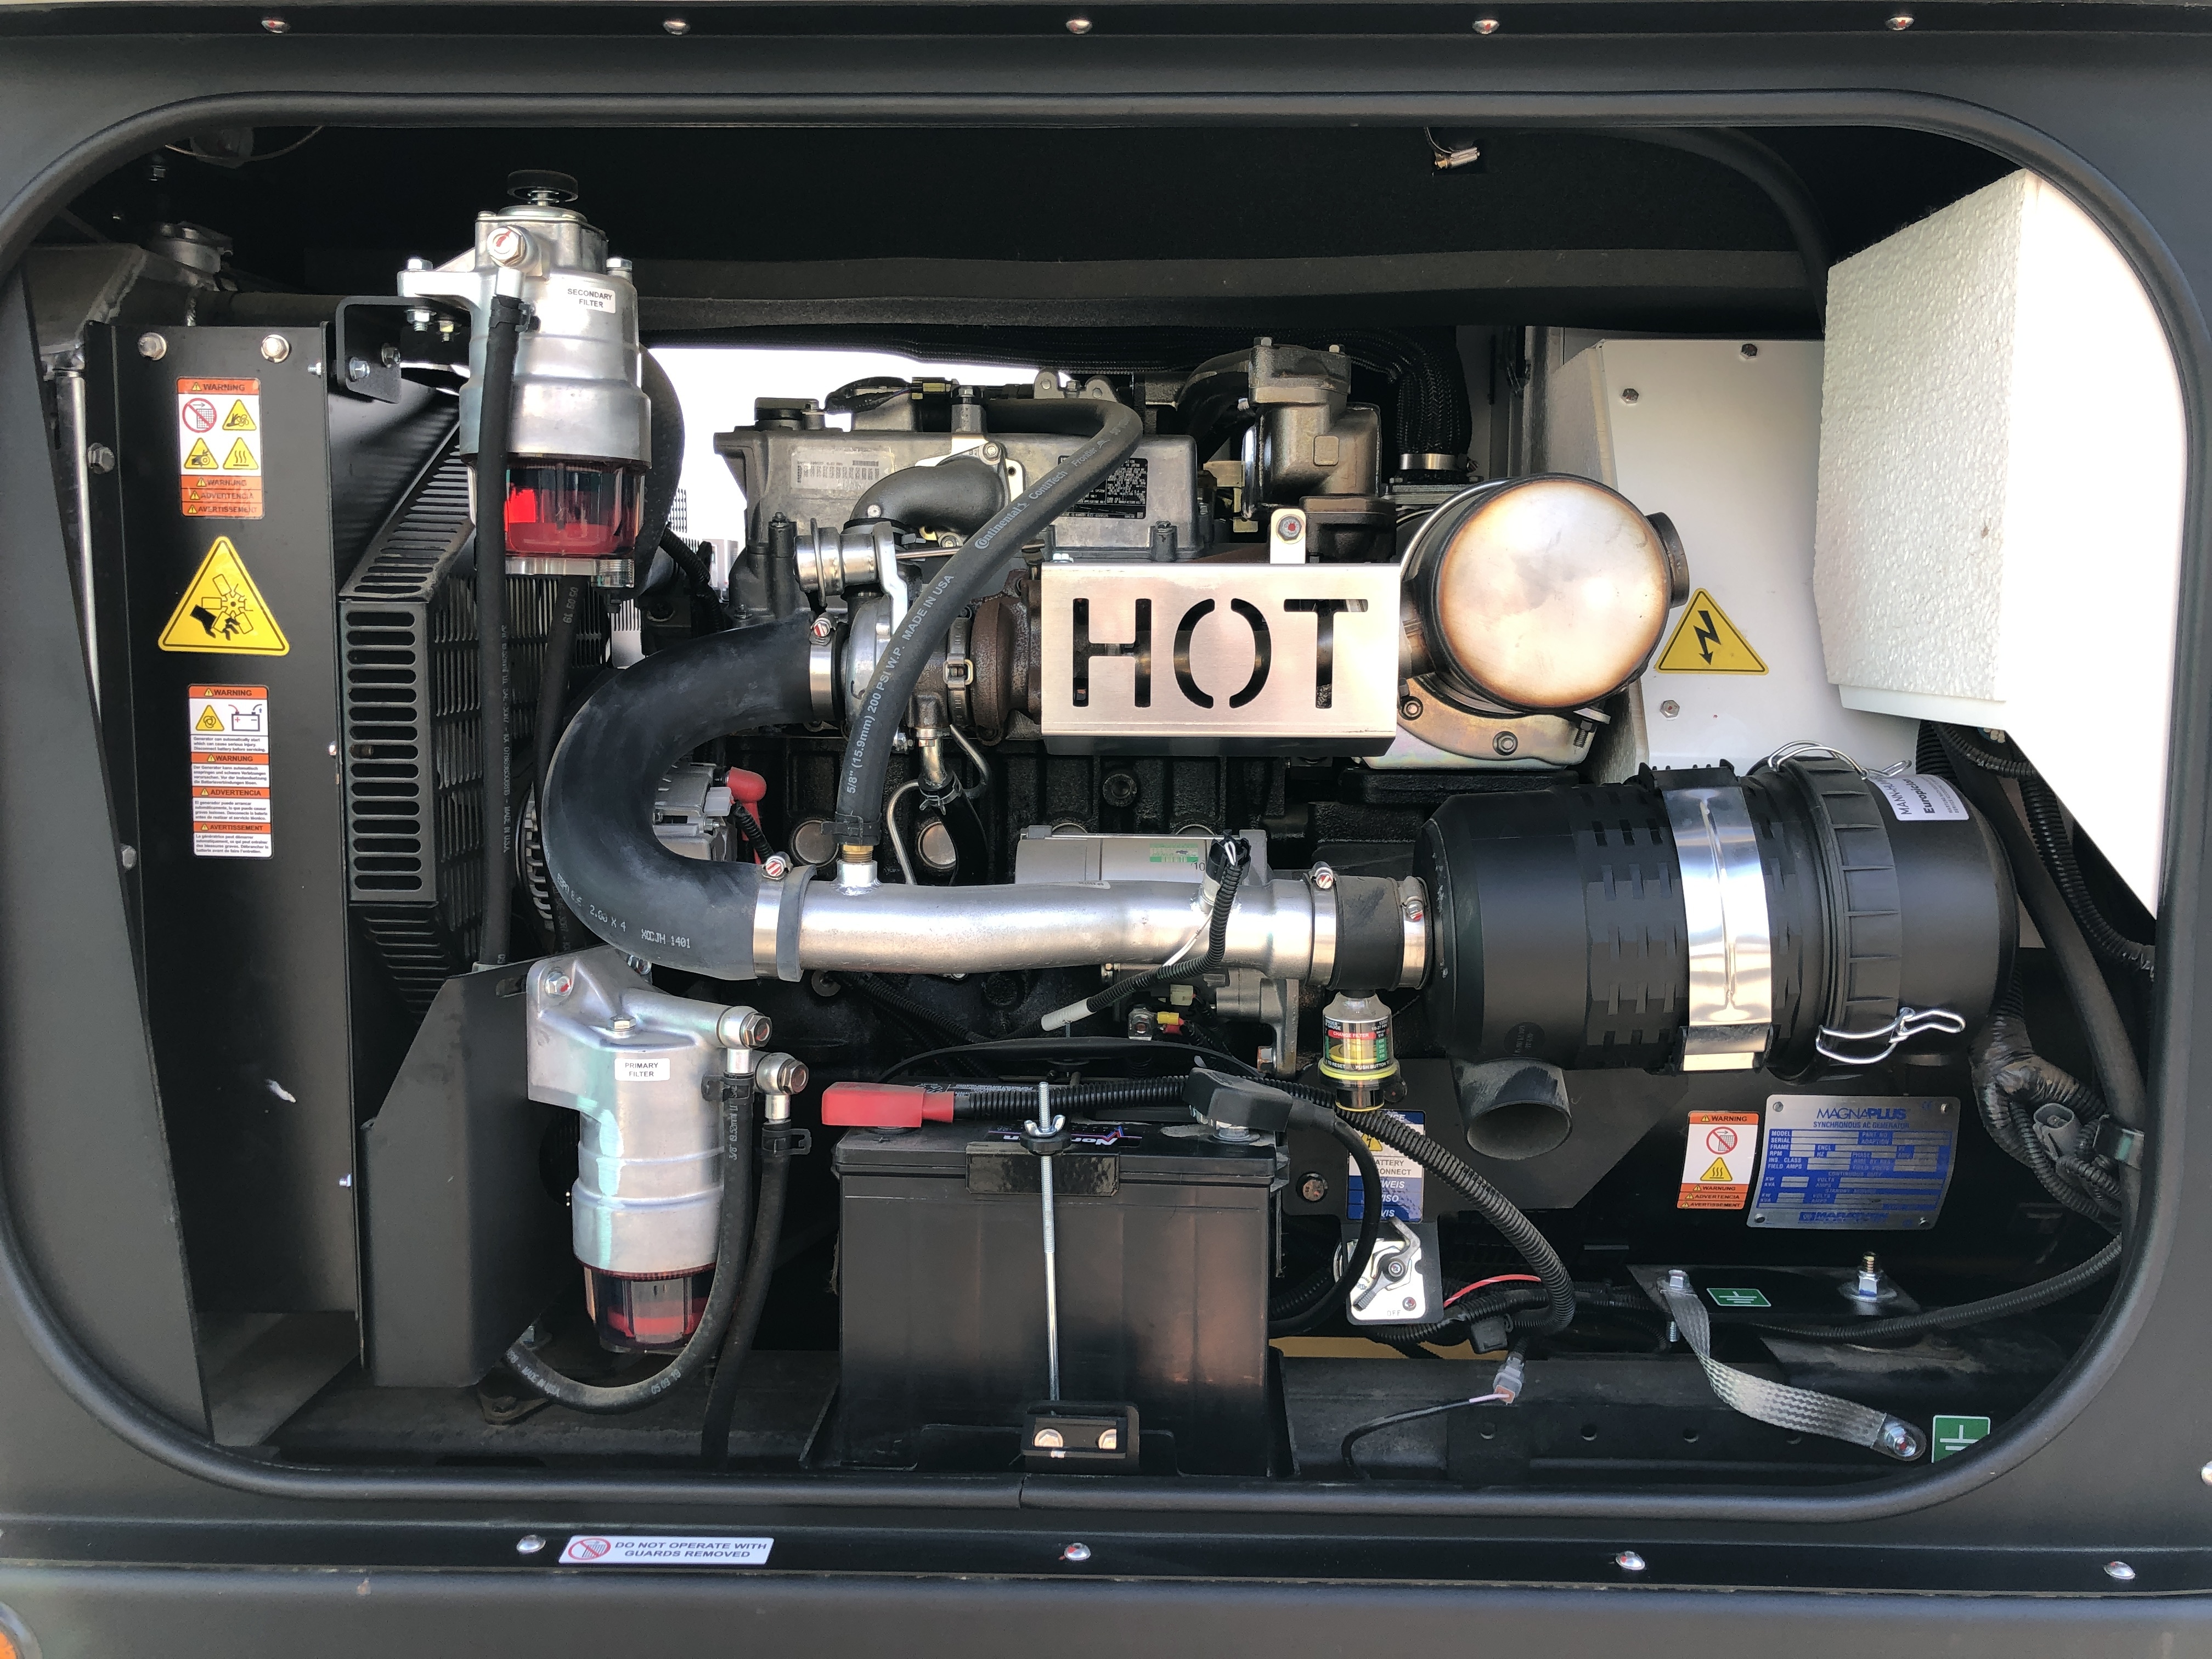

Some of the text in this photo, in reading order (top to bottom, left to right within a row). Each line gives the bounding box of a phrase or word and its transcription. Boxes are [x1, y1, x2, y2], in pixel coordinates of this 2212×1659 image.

[567, 288, 612, 301] SECONDARY
[579, 299, 603, 308] FILTER
[974, 505, 1021, 549] Continental
[1029, 471, 1068, 500] ContiTech
[1071, 447, 1097, 466] Frontier
[1072, 598, 1368, 708] HOT
[847, 575, 955, 794] 5/8" (15.9mm) 200 PSI W.P. MADE IN USA
[504, 826, 511, 835] IN
[620, 921, 626, 932] 4
[670, 935, 691, 949] 1401
[1816, 1107, 1906, 1120] MAGNAPLUS
[1382, 1194, 1400, 1203] ISO
[1381, 1209, 1395, 1217] VIS
